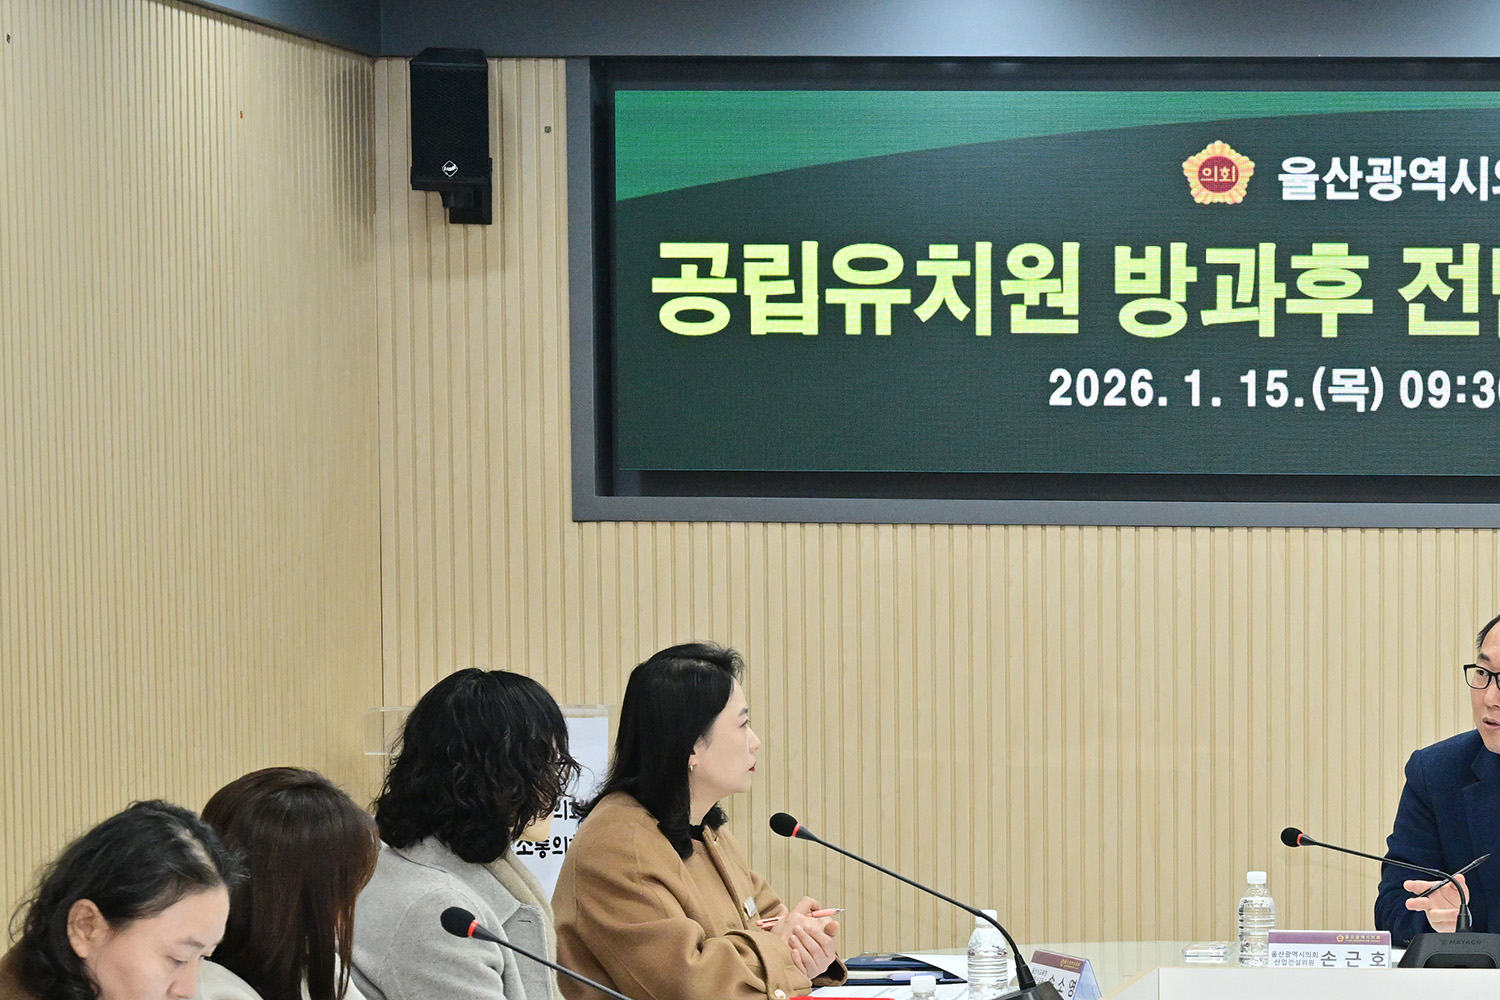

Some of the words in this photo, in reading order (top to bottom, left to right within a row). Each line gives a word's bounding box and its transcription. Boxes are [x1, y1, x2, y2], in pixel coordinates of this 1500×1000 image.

[1200, 165, 1236, 183] 의회
[651, 240, 1080, 337] 공립유치원
[1114, 242, 1374, 338] 방과후
[1048, 368, 1168, 407] 2026.
[1184, 369, 1221, 407] 1.
[1240, 366, 1384, 413] 15.(목)
[1271, 950, 1319, 959] 울산광역시의회
[1274, 958, 1315, 966] 산업건설위원
